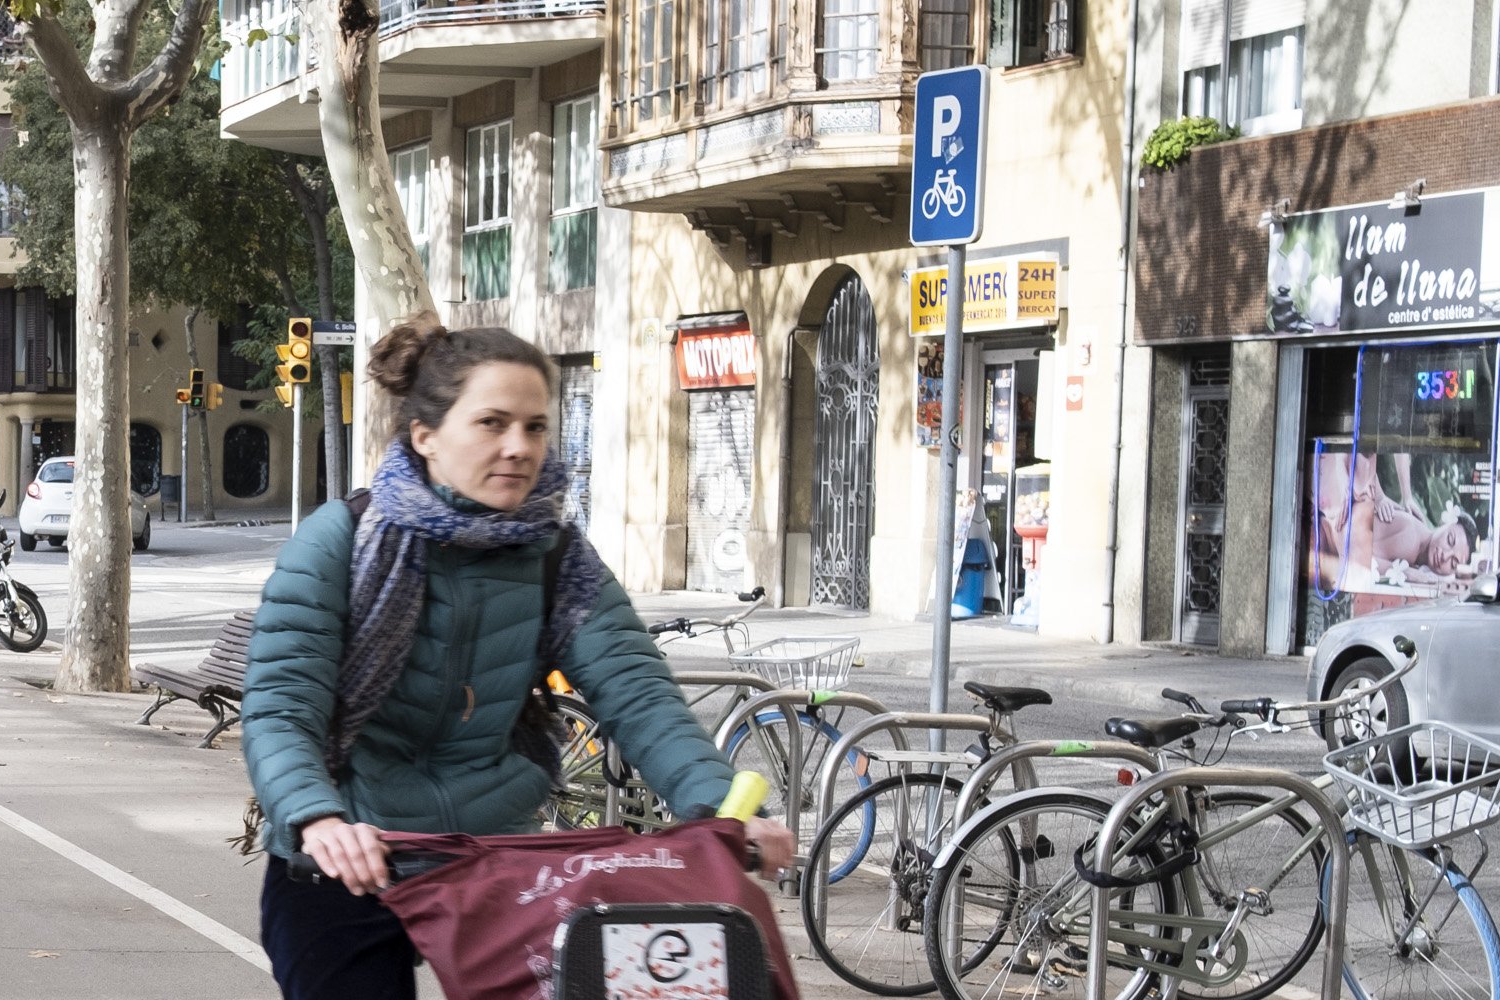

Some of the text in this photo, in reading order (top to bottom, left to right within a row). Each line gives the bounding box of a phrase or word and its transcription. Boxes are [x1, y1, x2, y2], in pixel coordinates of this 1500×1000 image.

[932, 95, 962, 158] P
[1345, 214, 1407, 261] llum
[919, 271, 1008, 309] SUPMERC
[1019, 268, 1055, 282] 24H
[1353, 259, 1477, 307] de lluna
[1018, 289, 1056, 300] SUPER
[1018, 305, 1056, 314] MERCAT
[1388, 309, 1421, 325] centre
[1432, 303, 1475, 322] estética
[682, 334, 757, 378] MOTOPRIX
